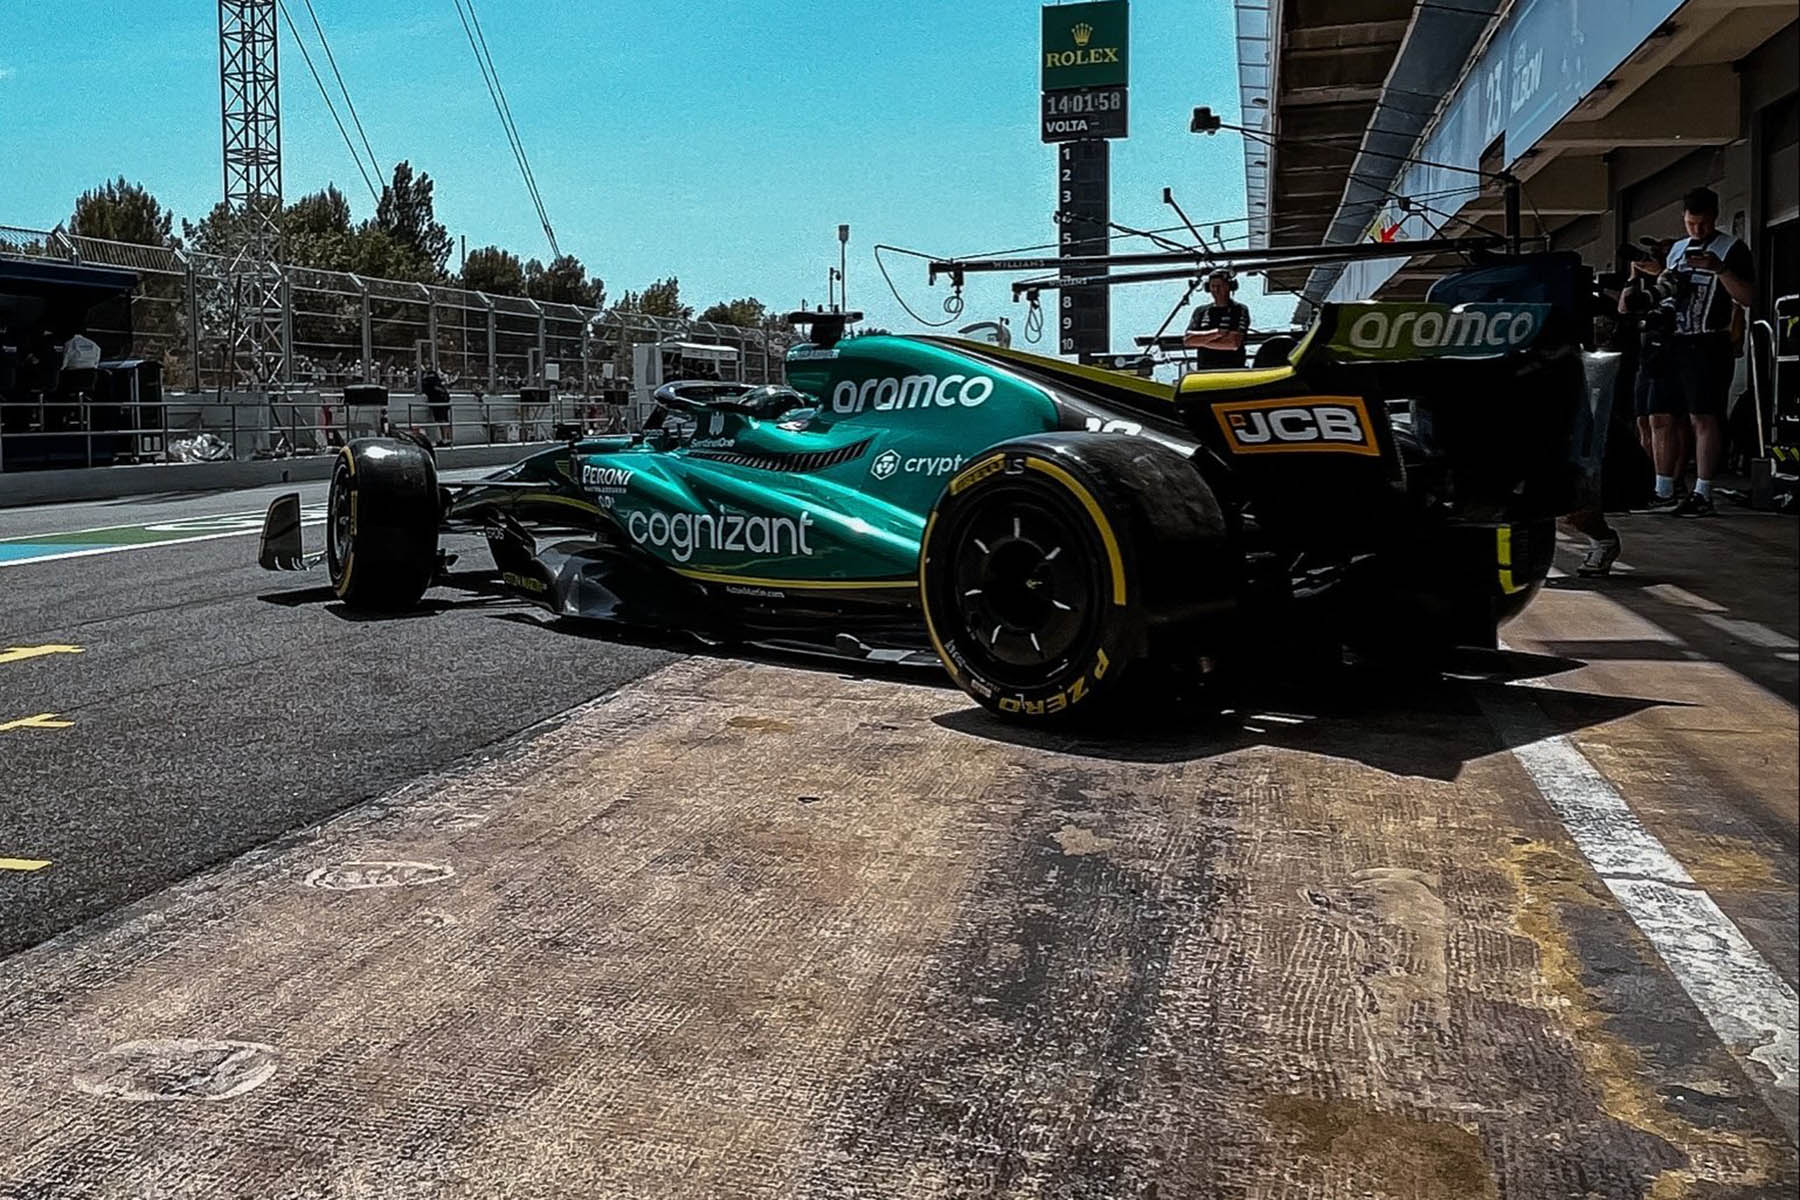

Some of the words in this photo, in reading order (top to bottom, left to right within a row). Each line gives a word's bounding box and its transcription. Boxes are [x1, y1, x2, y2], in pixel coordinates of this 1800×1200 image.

[1046, 48, 1119, 67] ROLEX
[1046, 120, 1088, 133] VOLTA
[1062, 148, 1070, 160] 1
[1062, 169, 1071, 181] 2
[1062, 190, 1072, 203] 3
[1062, 232, 1072, 244] 5
[992, 260, 1046, 269] WILLIAMS
[1062, 296, 1072, 308] 8
[1062, 317, 1072, 329] 9
[1349, 311, 1534, 349] aramco
[1061, 338, 1074, 350] 10
[833, 374, 994, 413] aramco
[1235, 407, 1363, 444] JCB
[904, 454, 969, 476] crypt
[583, 465, 634, 485] PERONI
[628, 505, 813, 562] cognizant
[999, 677, 1090, 715] ZERO
